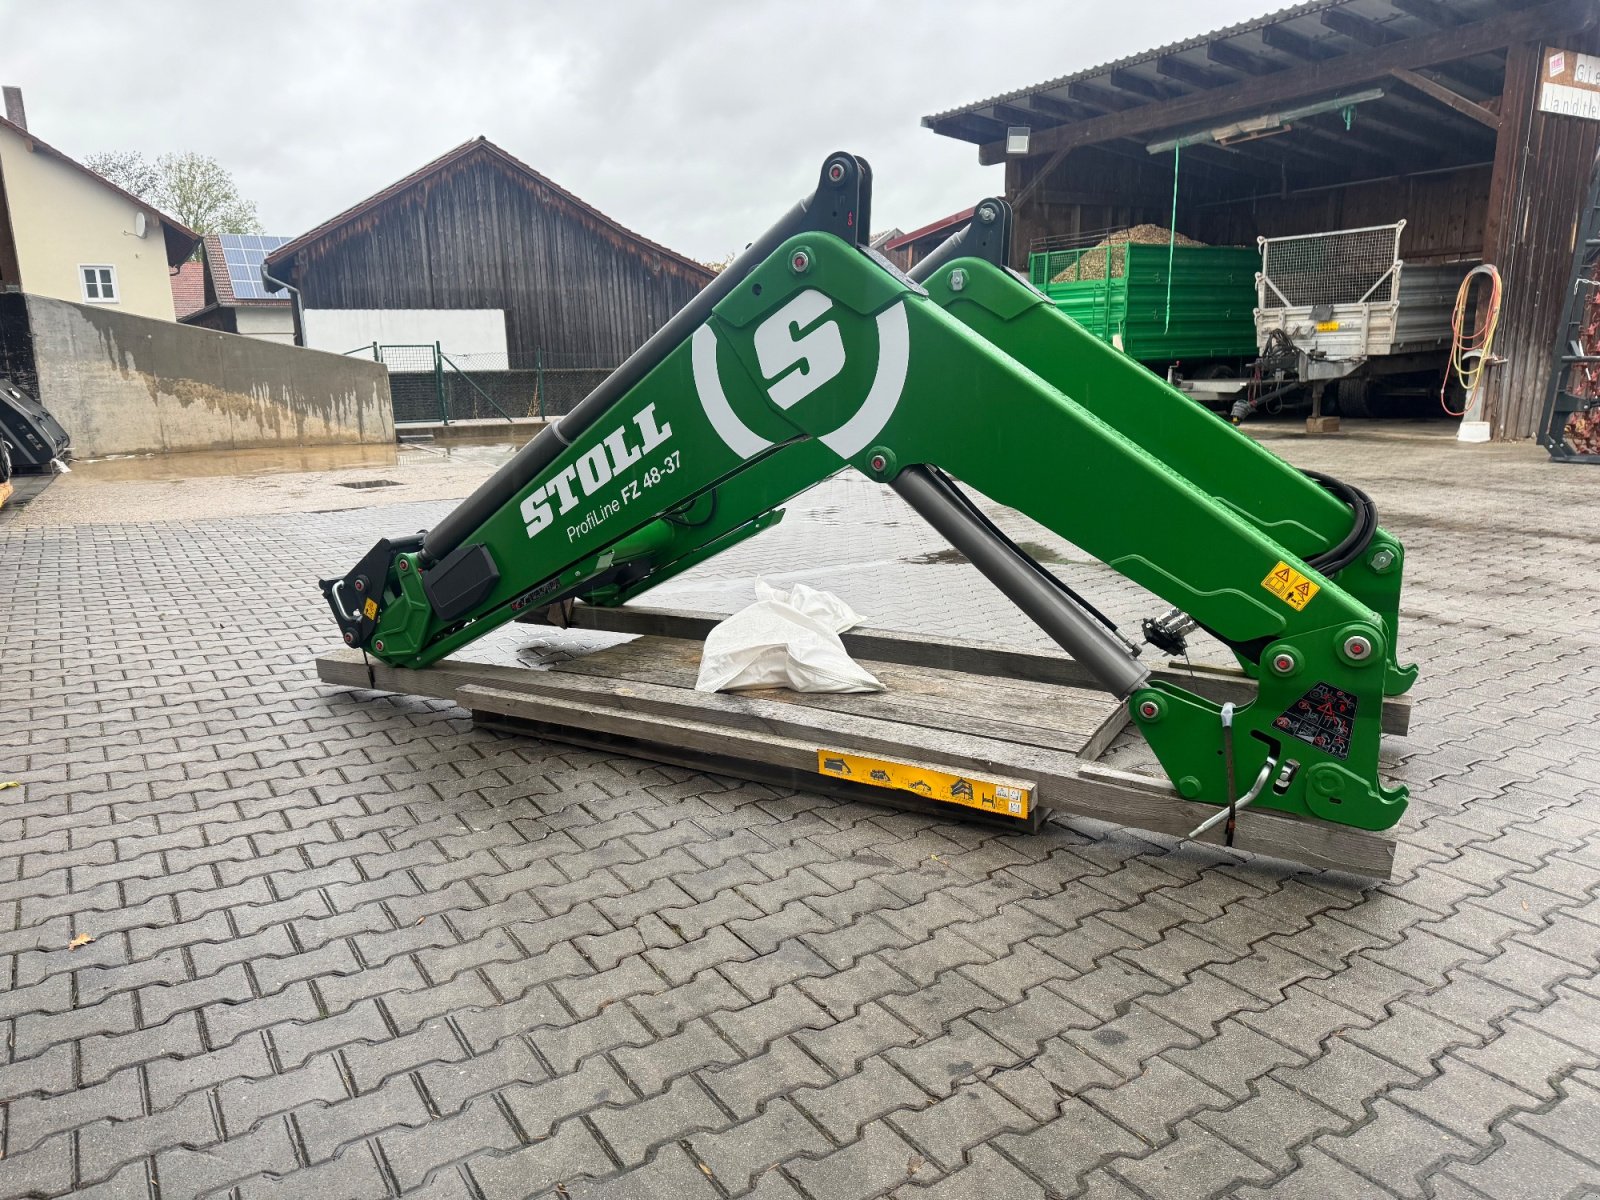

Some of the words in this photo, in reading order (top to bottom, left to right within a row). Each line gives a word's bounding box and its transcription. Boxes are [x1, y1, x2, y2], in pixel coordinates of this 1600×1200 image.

[753, 288, 847, 411] S
[519, 401, 673, 539] STOLL
[566, 499, 621, 543] ProfiLine
[620, 479, 642, 505] FZ
[643, 449, 681, 488] 48-37
